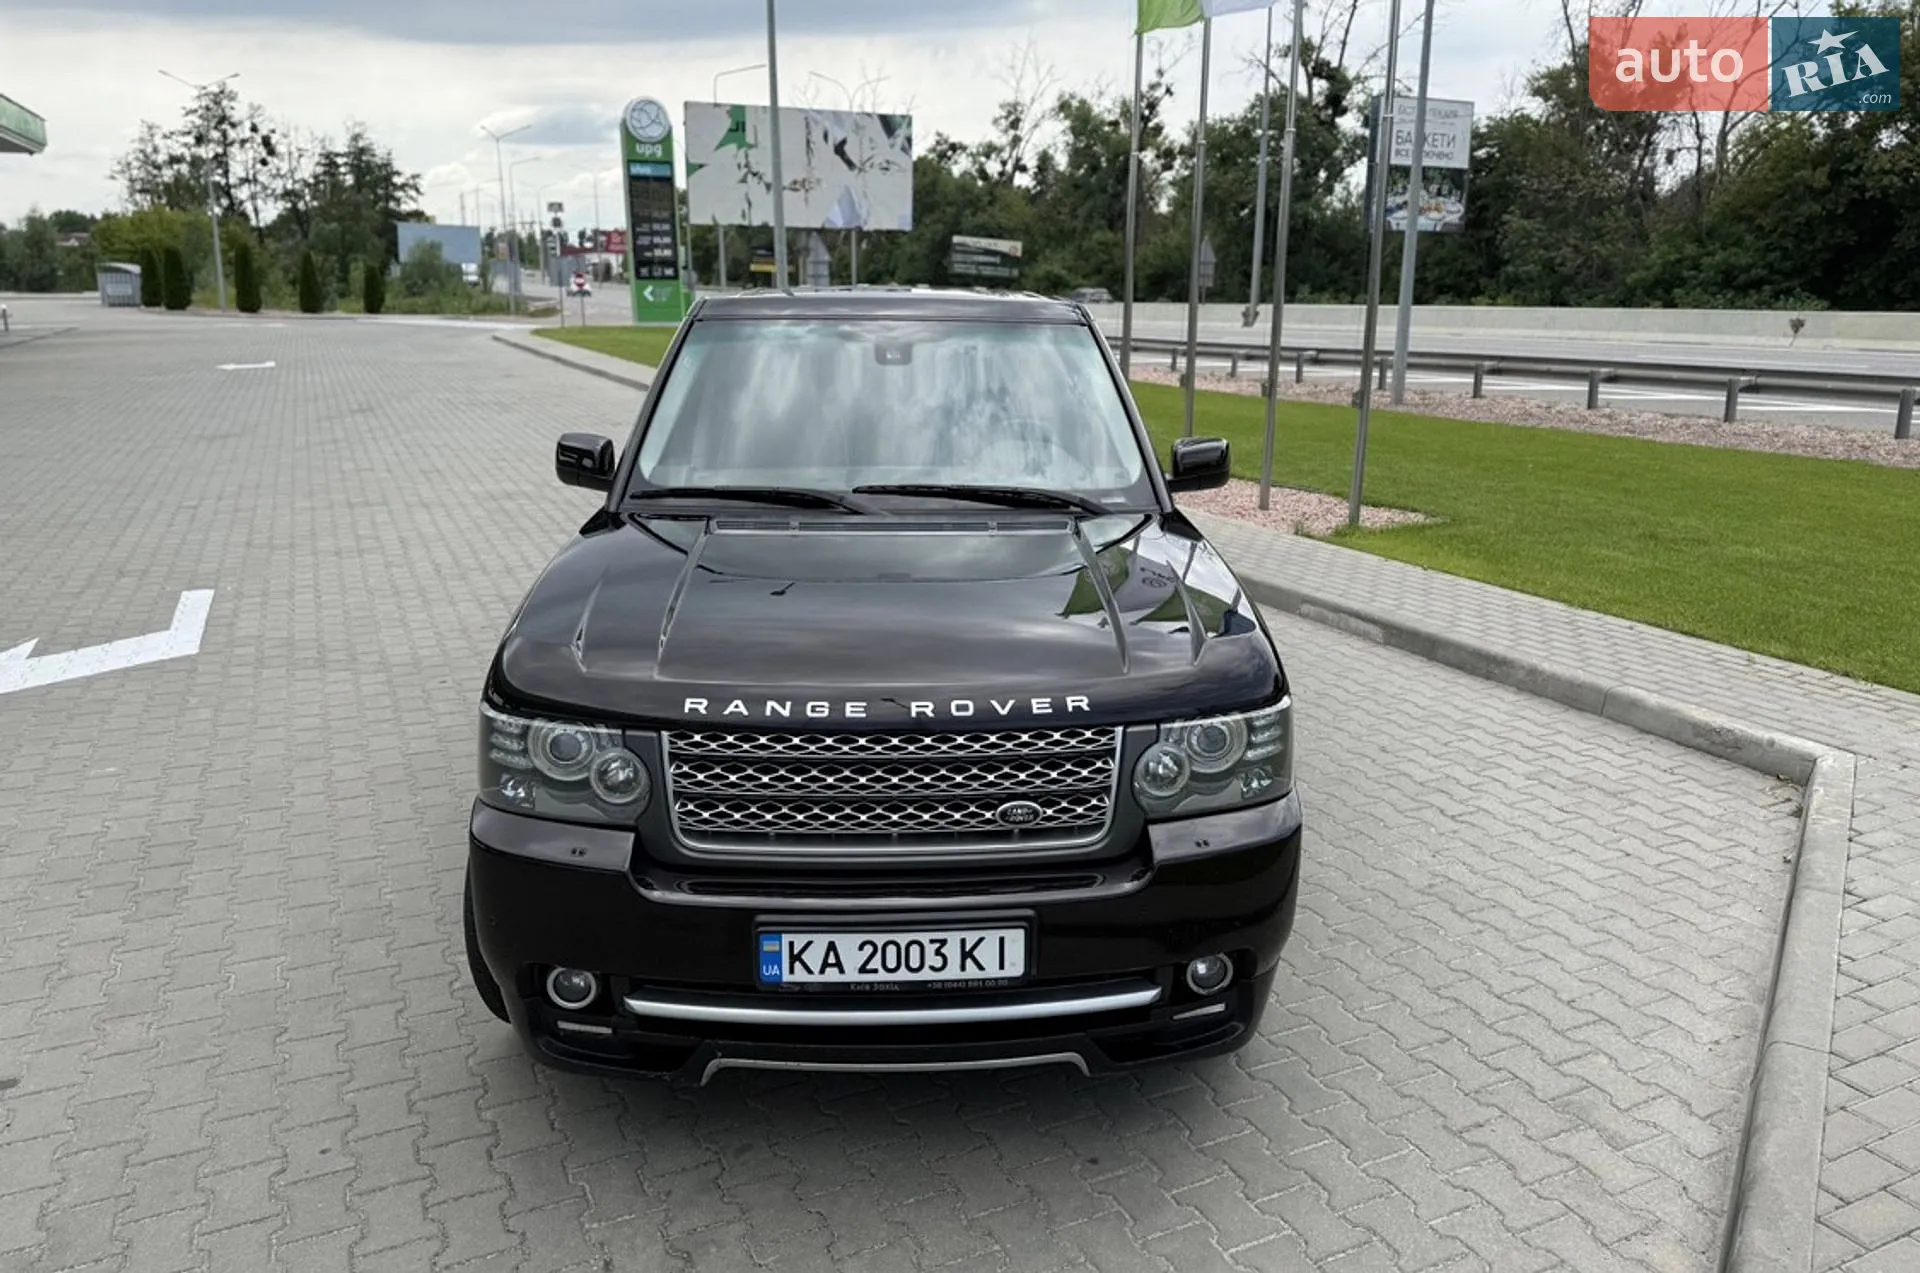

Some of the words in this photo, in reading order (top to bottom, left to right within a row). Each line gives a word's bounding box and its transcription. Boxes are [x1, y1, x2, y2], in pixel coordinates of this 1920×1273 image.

[1395, 129, 1457, 149] БАКЕТИ
[635, 143, 662, 158] upg
[683, 697, 868, 718] RANGE
[910, 695, 1092, 718] ROVER
[857, 938, 949, 975] 2003
[763, 965, 780, 976] UA
